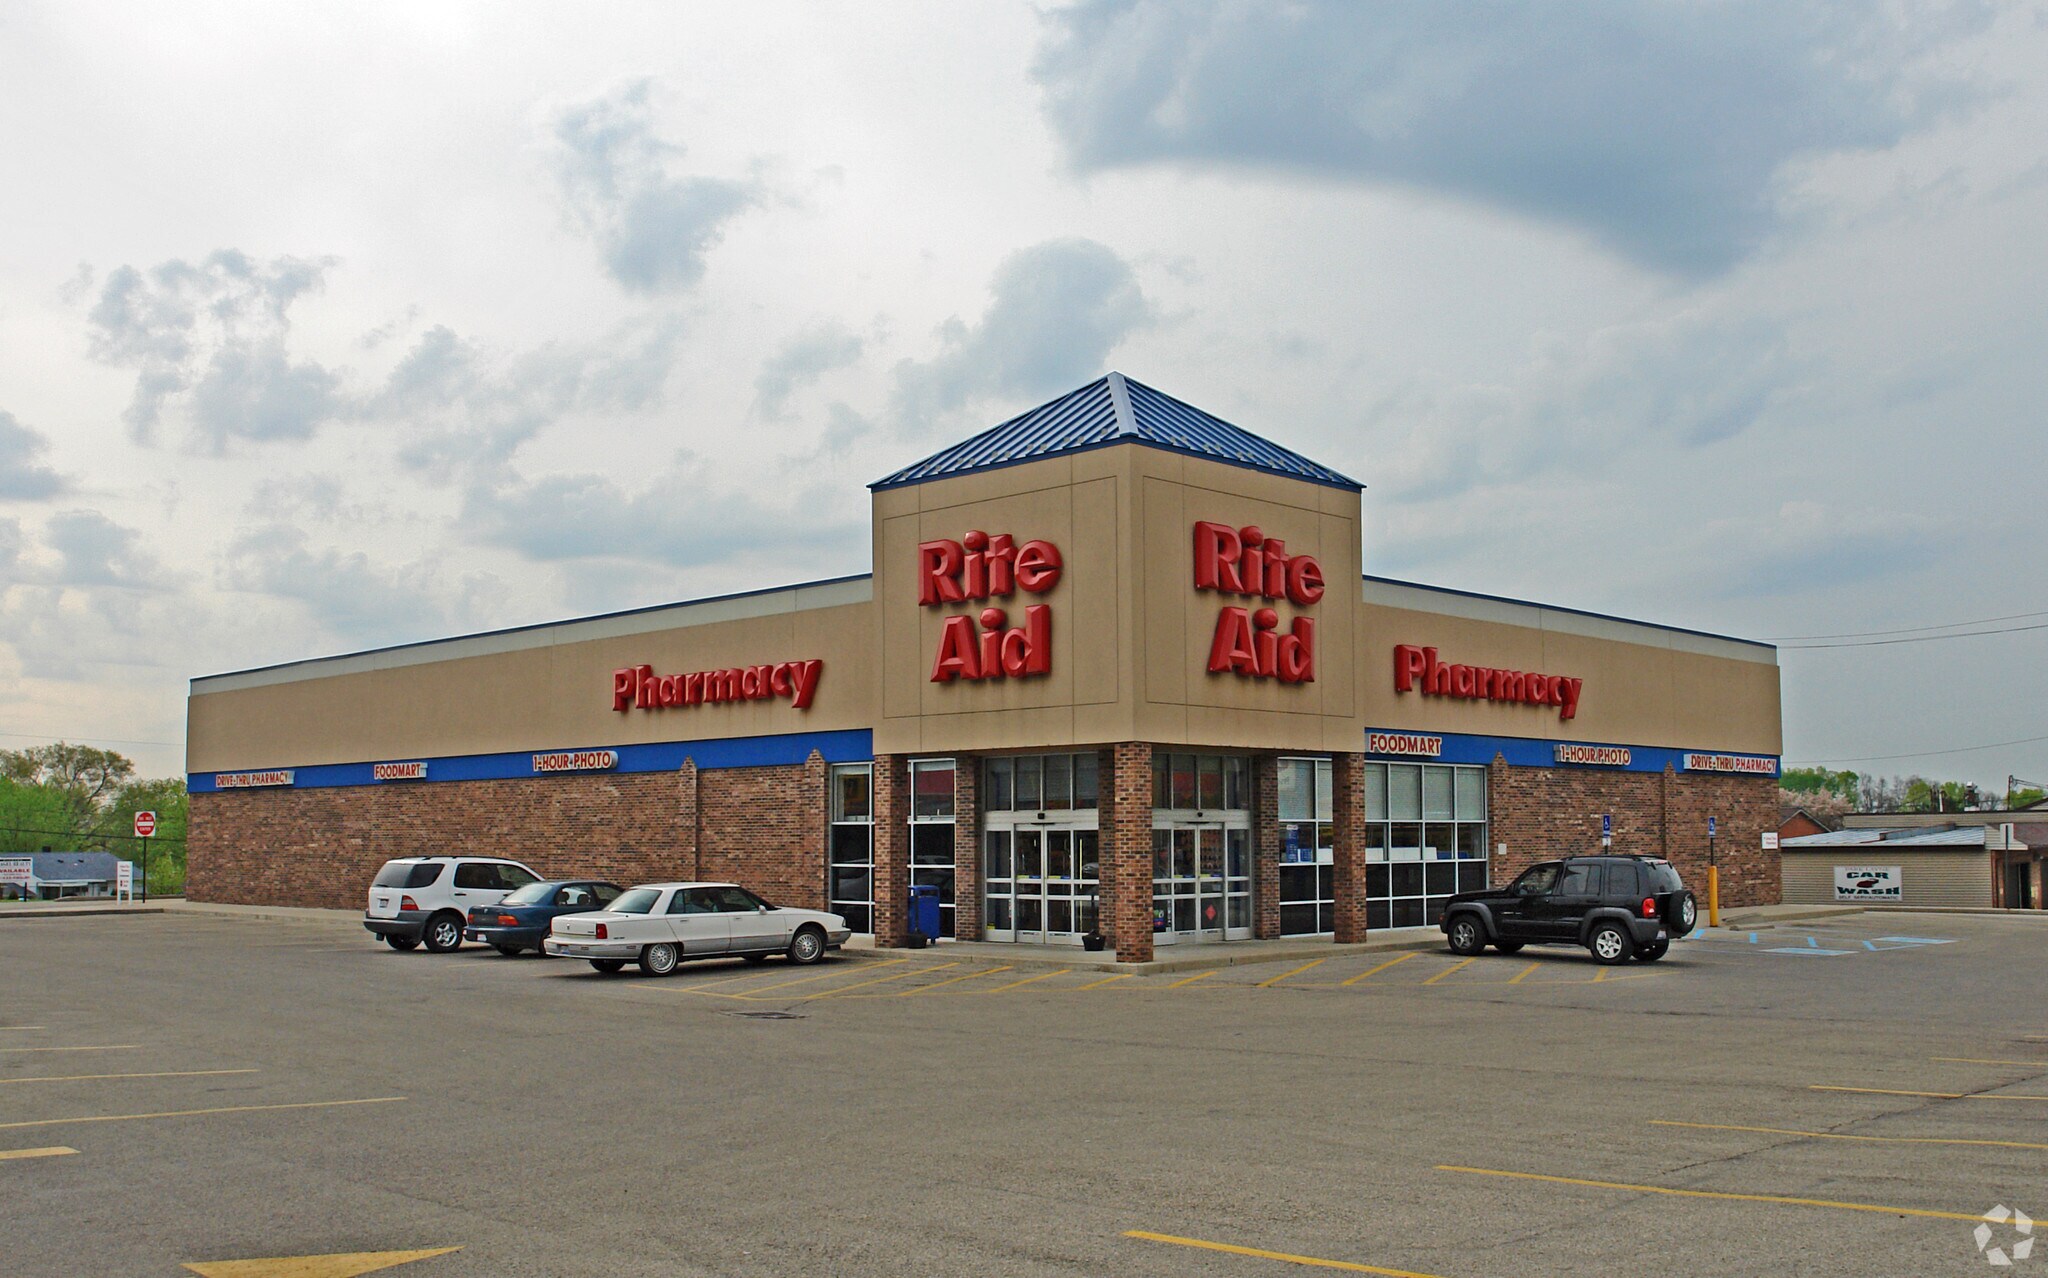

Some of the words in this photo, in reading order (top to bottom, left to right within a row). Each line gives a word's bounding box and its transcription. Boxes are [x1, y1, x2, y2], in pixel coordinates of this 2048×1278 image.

[918, 530, 1063, 606] Rite
[1193, 520, 1325, 605] Rite
[930, 604, 1050, 682] Aid
[1207, 606, 1315, 683] Aid
[612, 659, 823, 712] Pharmacy
[1394, 644, 1582, 720] Pharmacy
[1370, 734, 1441, 754] FOODMART
[534, 754, 570, 770] 1-HOUR
[573, 752, 611, 768] PHOTO
[1561, 745, 1596, 763] 1-HOUR
[1598, 748, 1631, 764] PHOTO
[1690, 754, 1734, 771] DRIVE-THRU
[1735, 757, 1777, 773] PHARMACY
[216, 774, 250, 786] DRIVE-THRU
[251, 771, 289, 784] PHARMACY
[374, 764, 421, 779] FOODMART
[1837, 886, 1900, 894] WASH
